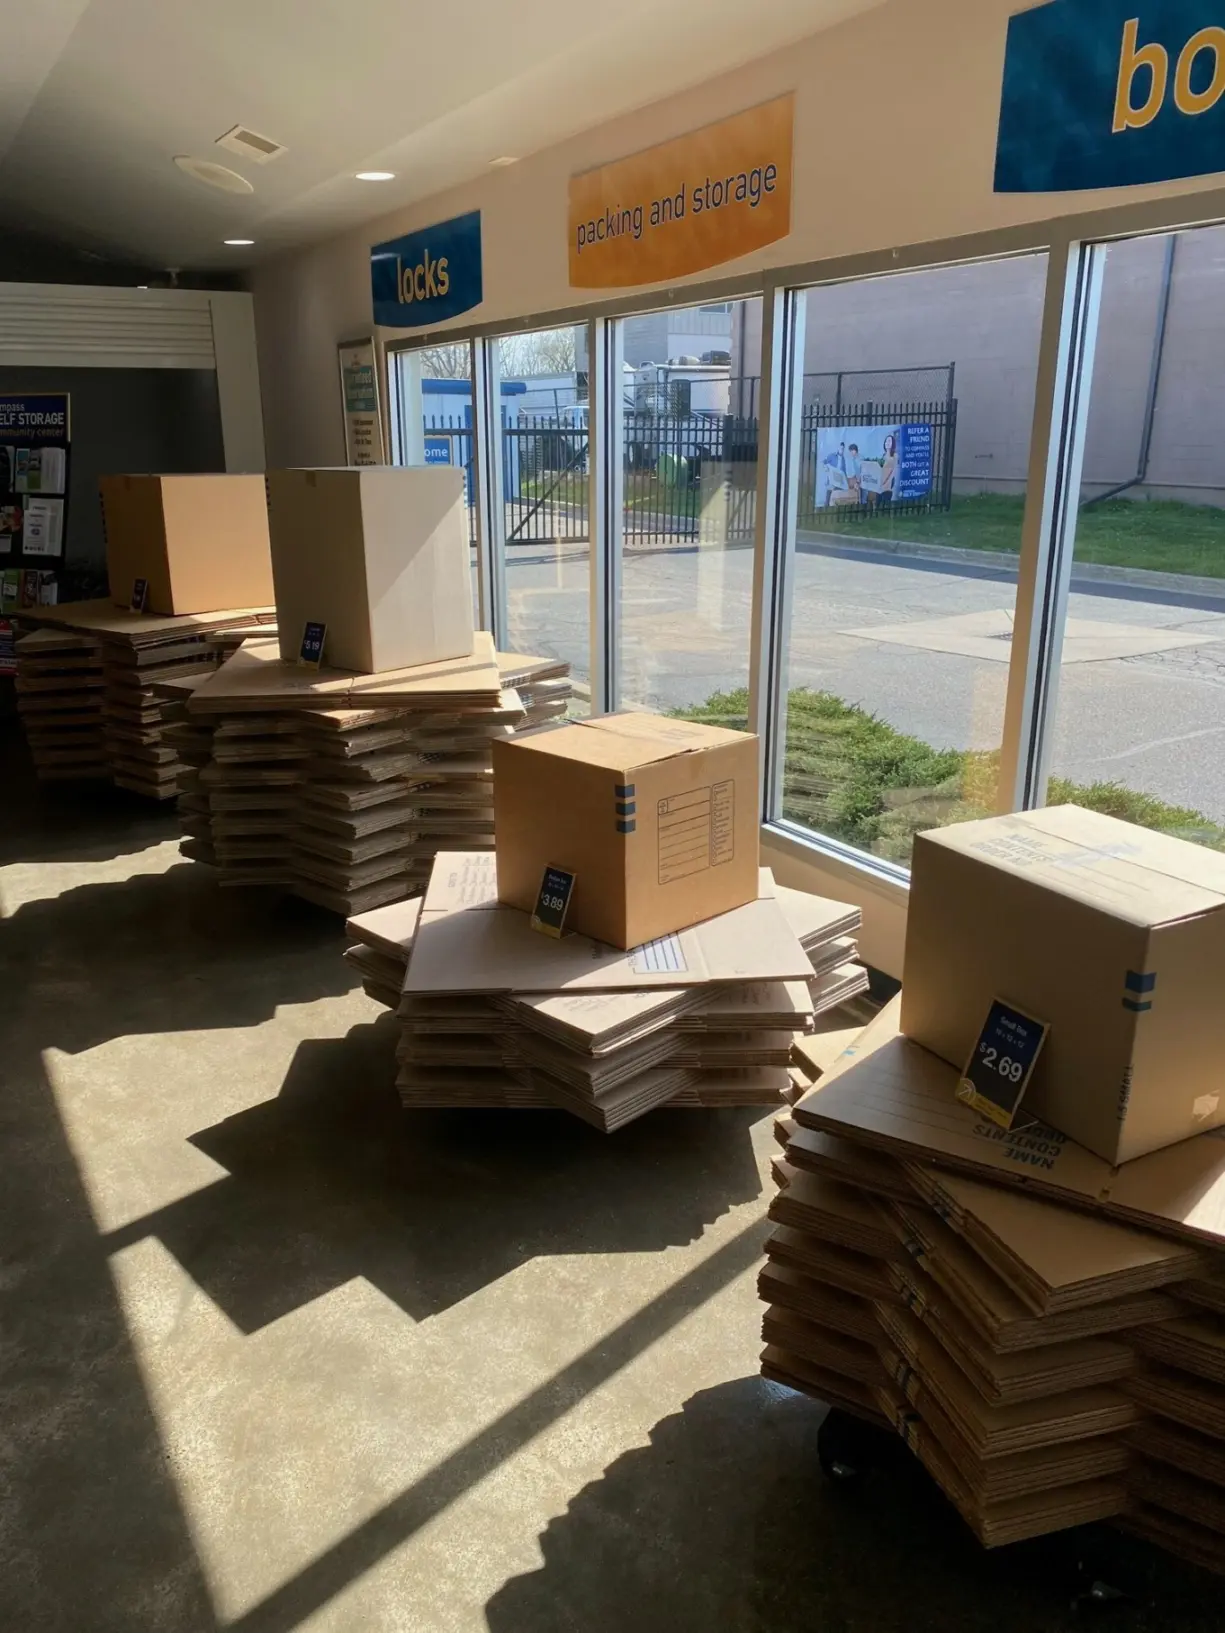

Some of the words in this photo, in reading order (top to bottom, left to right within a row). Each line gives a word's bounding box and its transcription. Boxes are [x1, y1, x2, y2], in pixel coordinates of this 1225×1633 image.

[576, 204, 643, 254] packing
[650, 182, 685, 226] and
[691, 162, 777, 213] storage
[397, 248, 449, 304] locks
[18, 412, 65, 425] STORAGE
[907, 427, 924, 435] REFER
[909, 435, 930, 443] FRIEND
[910, 469, 929, 477] GREAT
[900, 478, 929, 487] DISCOUNT
[980, 1042, 1022, 1083] $2.69
[972, 1124, 1061, 1157] CONTENTS
[1003, 1147, 1055, 1170] NAME
